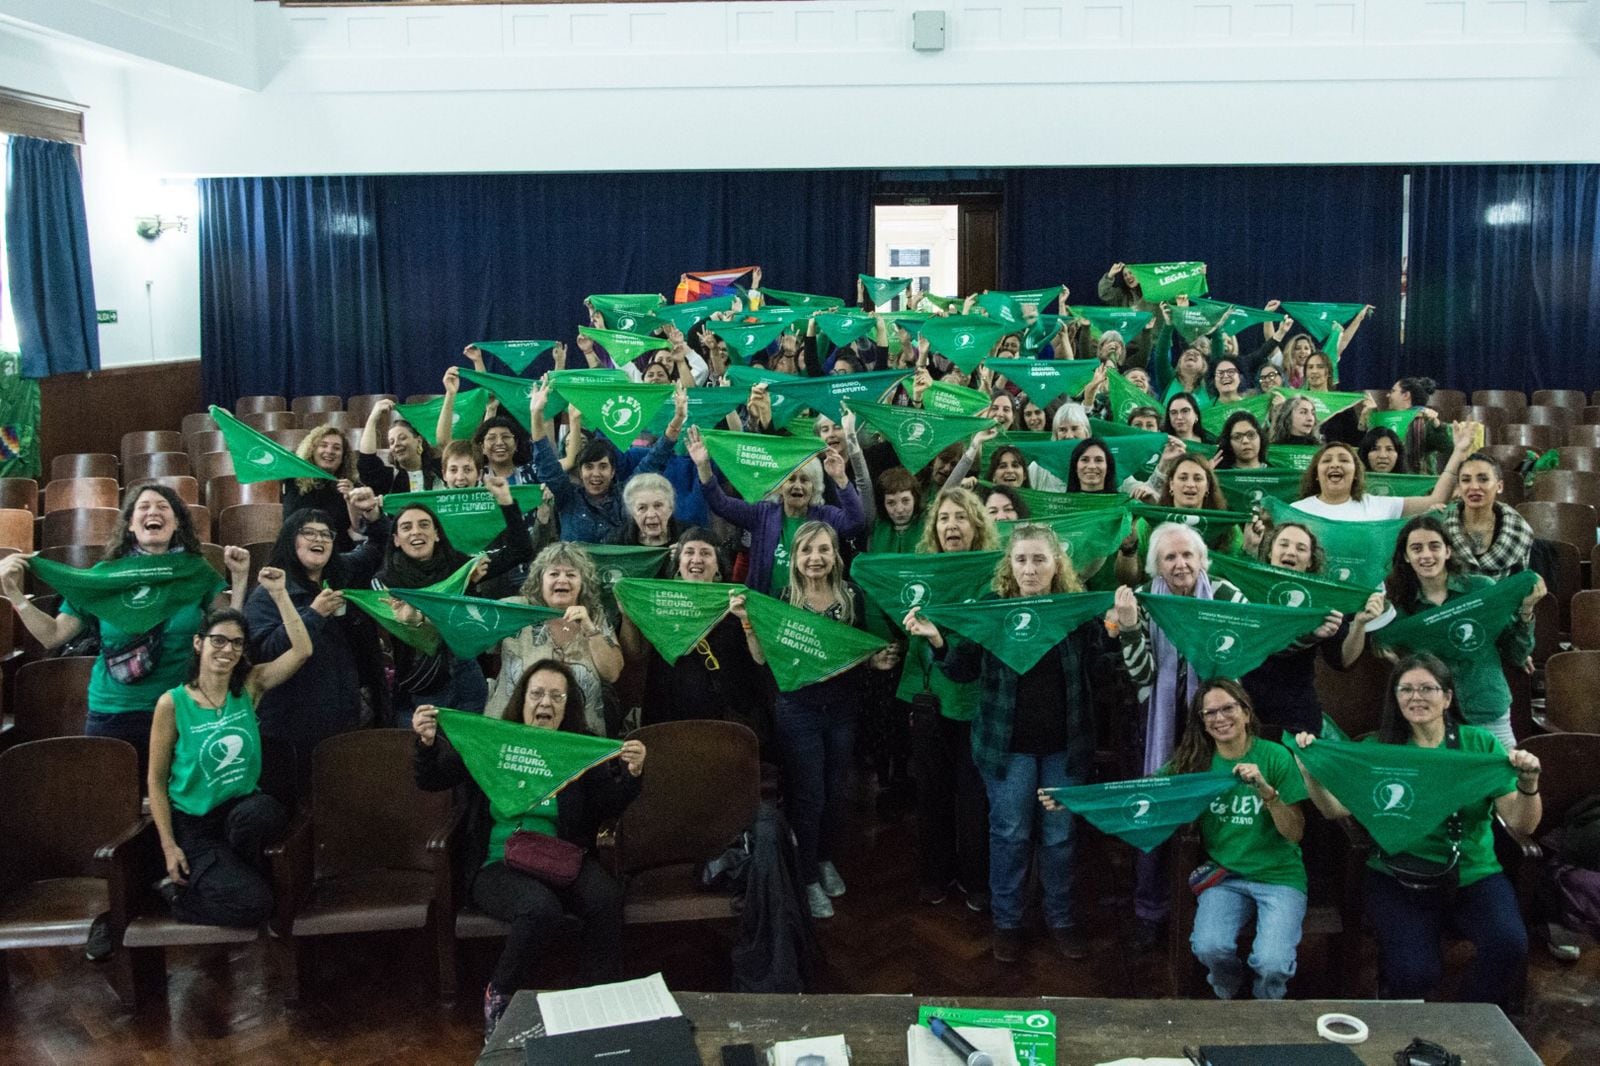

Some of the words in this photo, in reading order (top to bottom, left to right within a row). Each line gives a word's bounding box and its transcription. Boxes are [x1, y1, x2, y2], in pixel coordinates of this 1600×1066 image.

[1160, 271, 1189, 286] LEGAL
[742, 445, 768, 454] LEGAL,
[740, 458, 779, 468] GRATUITO.
[741, 452, 773, 462] SEGURO,
[655, 590, 688, 599] LEGAL,
[655, 599, 696, 609] SEGURO,
[655, 608, 703, 617] GRATUITO.
[786, 619, 818, 638] LEGAL,
[783, 628, 822, 649] SEGURO,
[780, 636, 828, 660] GRATUITO.
[507, 745, 542, 758] LEGAL,
[505, 753, 548, 769] SEGURO,
[503, 761, 553, 778] GRATUITO.
[1231, 795, 1264, 815] LEY
